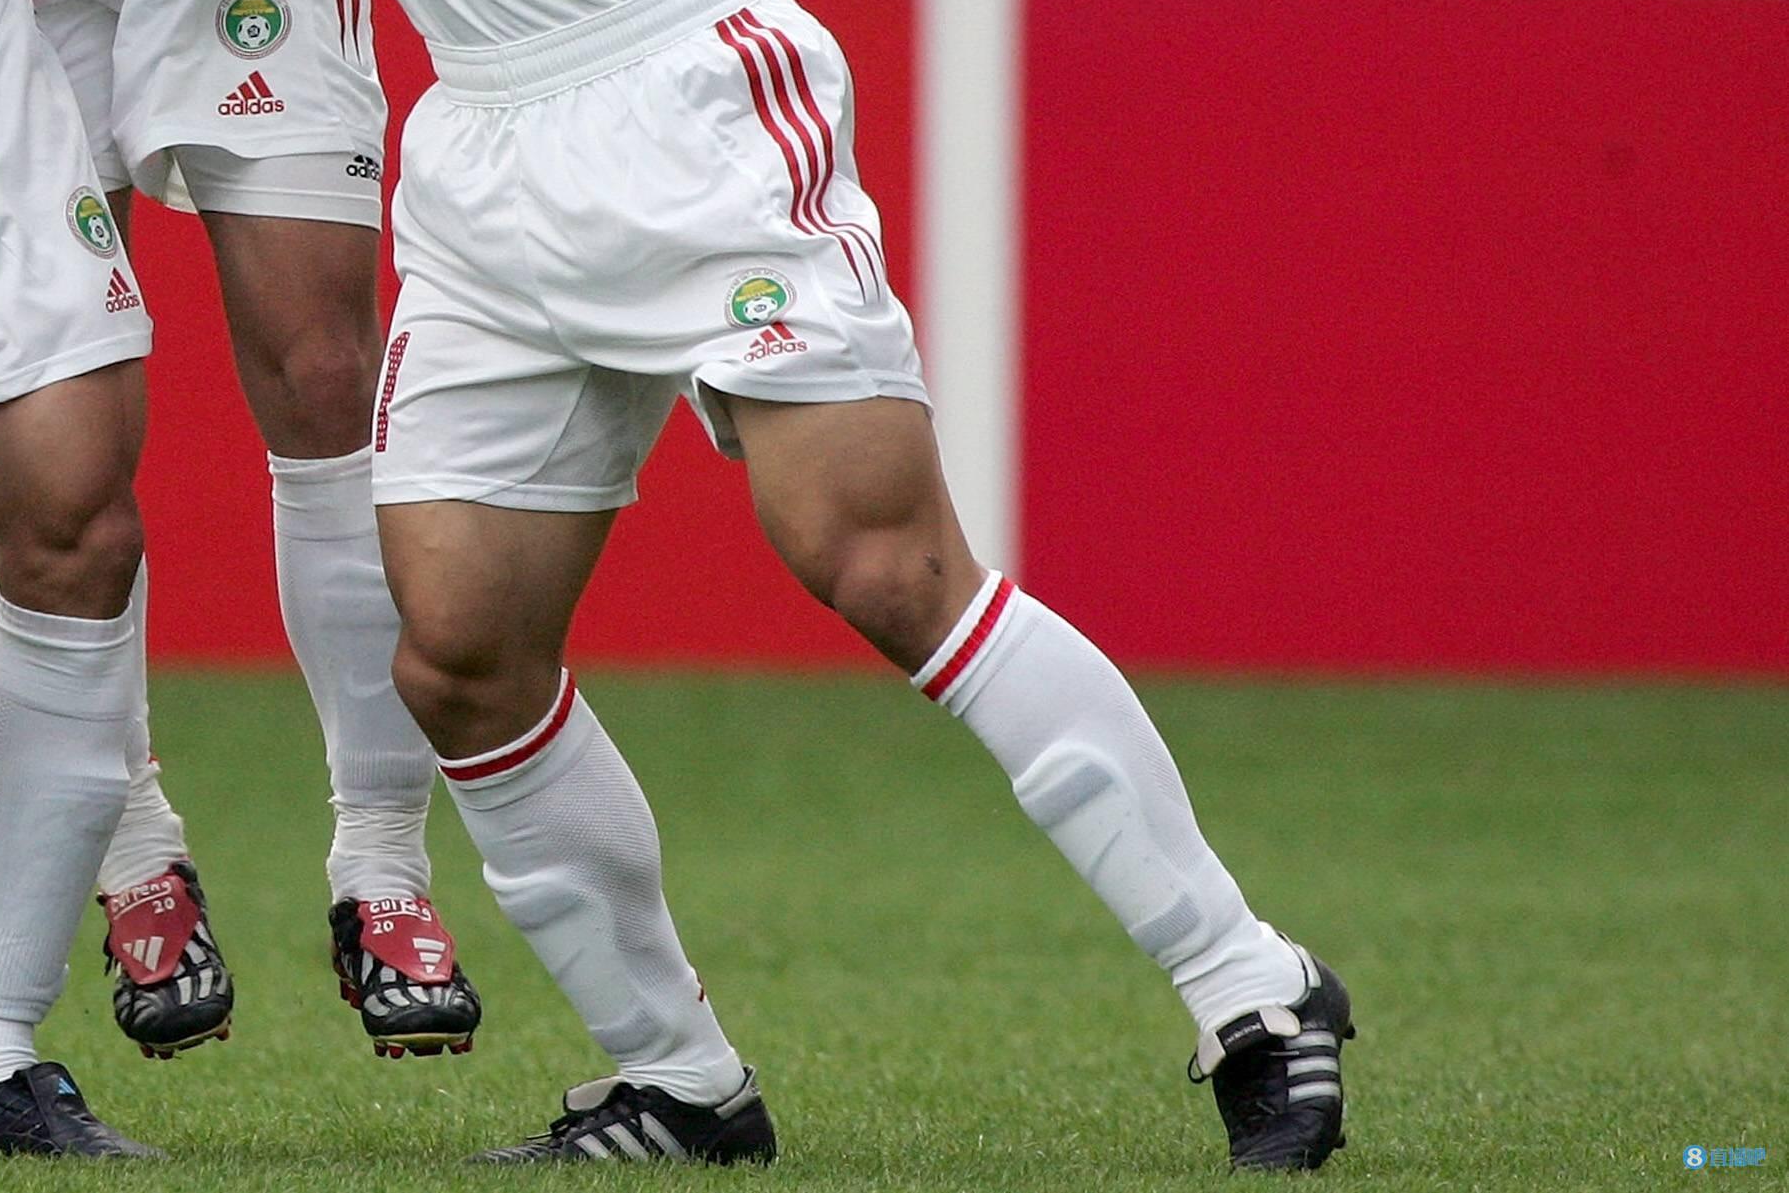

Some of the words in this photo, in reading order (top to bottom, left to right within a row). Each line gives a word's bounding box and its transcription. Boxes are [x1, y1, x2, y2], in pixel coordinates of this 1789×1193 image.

[217, 97, 285, 116] adidas
[105, 293, 141, 313] adidas
[743, 340, 809, 364] adidas
[152, 896, 176, 914] 20
[371, 920, 395, 935] 20
